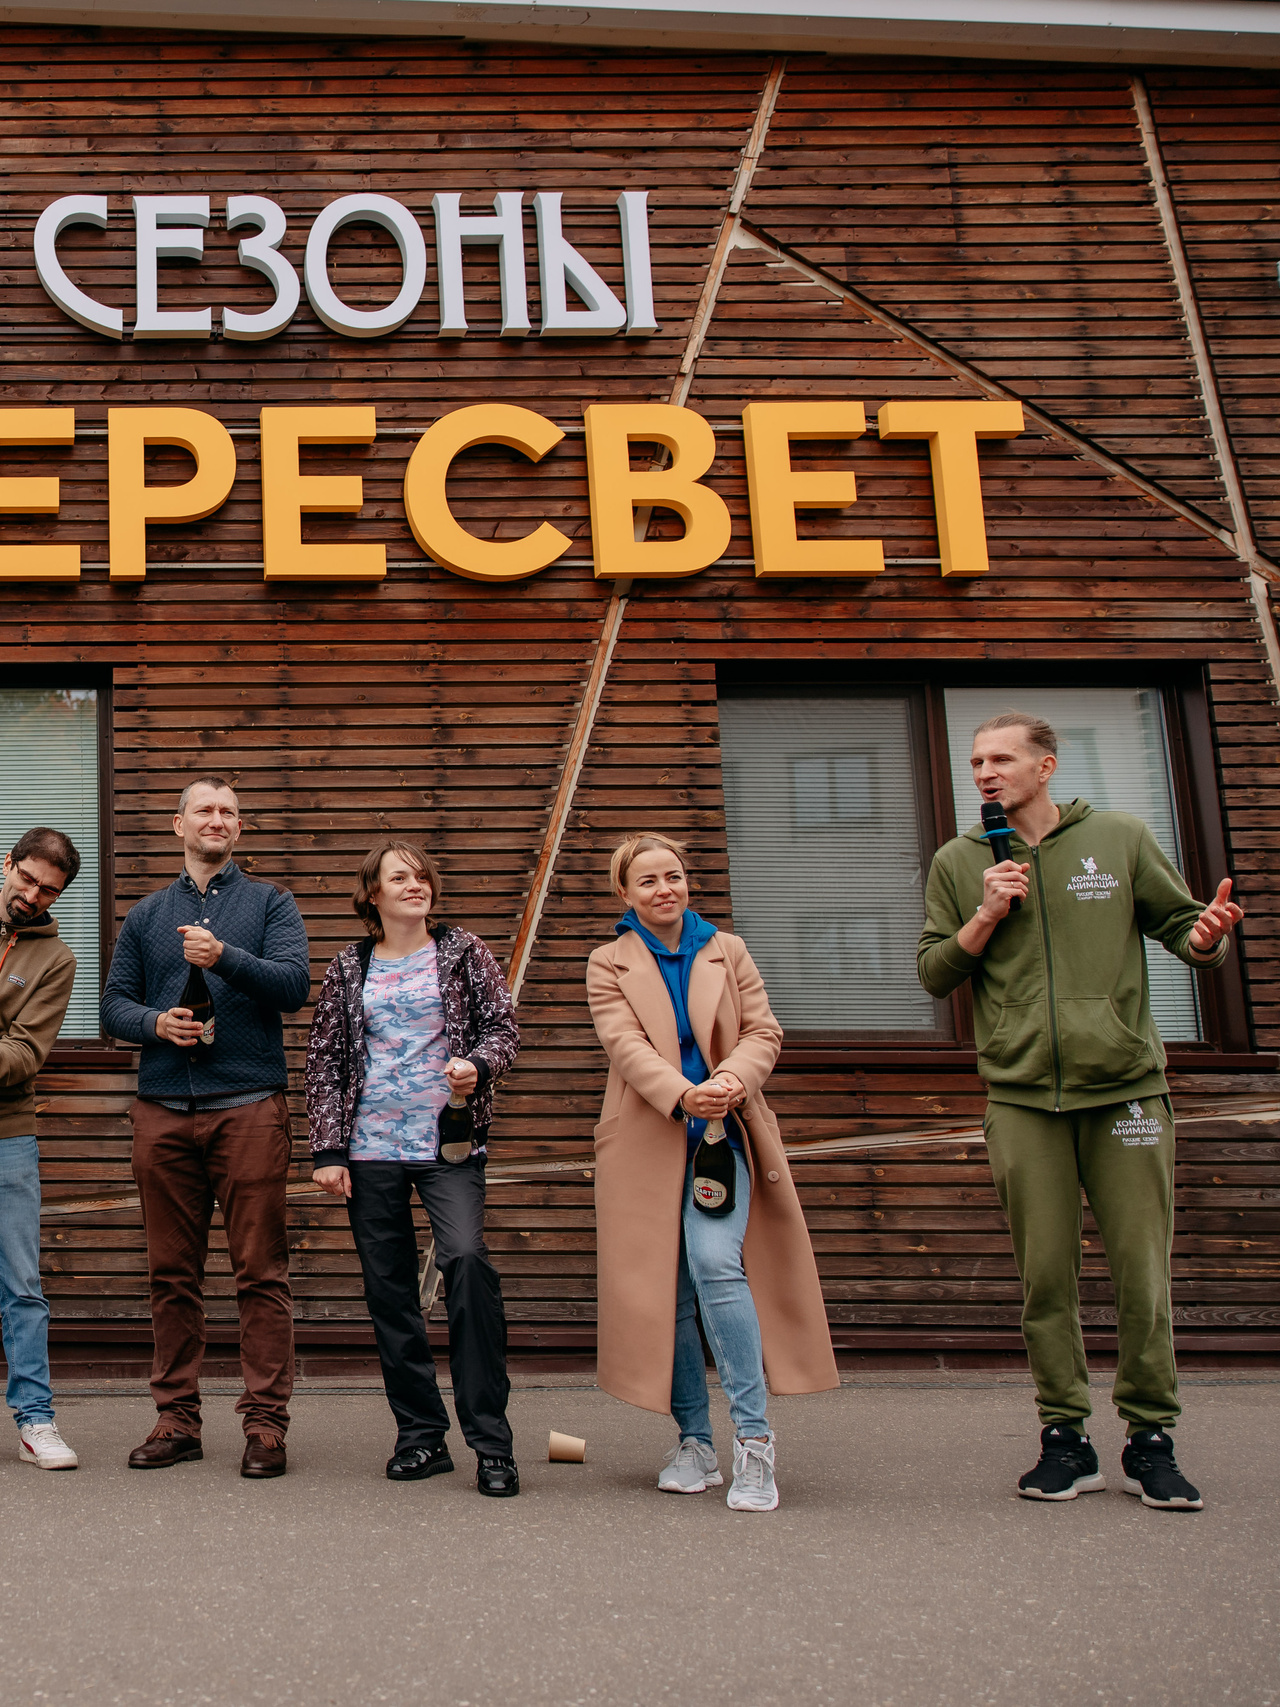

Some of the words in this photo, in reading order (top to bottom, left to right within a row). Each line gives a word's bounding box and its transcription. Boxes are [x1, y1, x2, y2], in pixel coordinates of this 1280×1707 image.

[33, 190, 662, 342] СЕЗОНЫ
[1071, 873, 1113, 882] КОМАНДА
[1066, 880, 1119, 891] АНИМАЦИИ
[1115, 1118, 1159, 1127] КОМАНДА
[1111, 1126, 1163, 1135] АНИМАЦИИ
[695, 1185, 722, 1197] MARTINI
